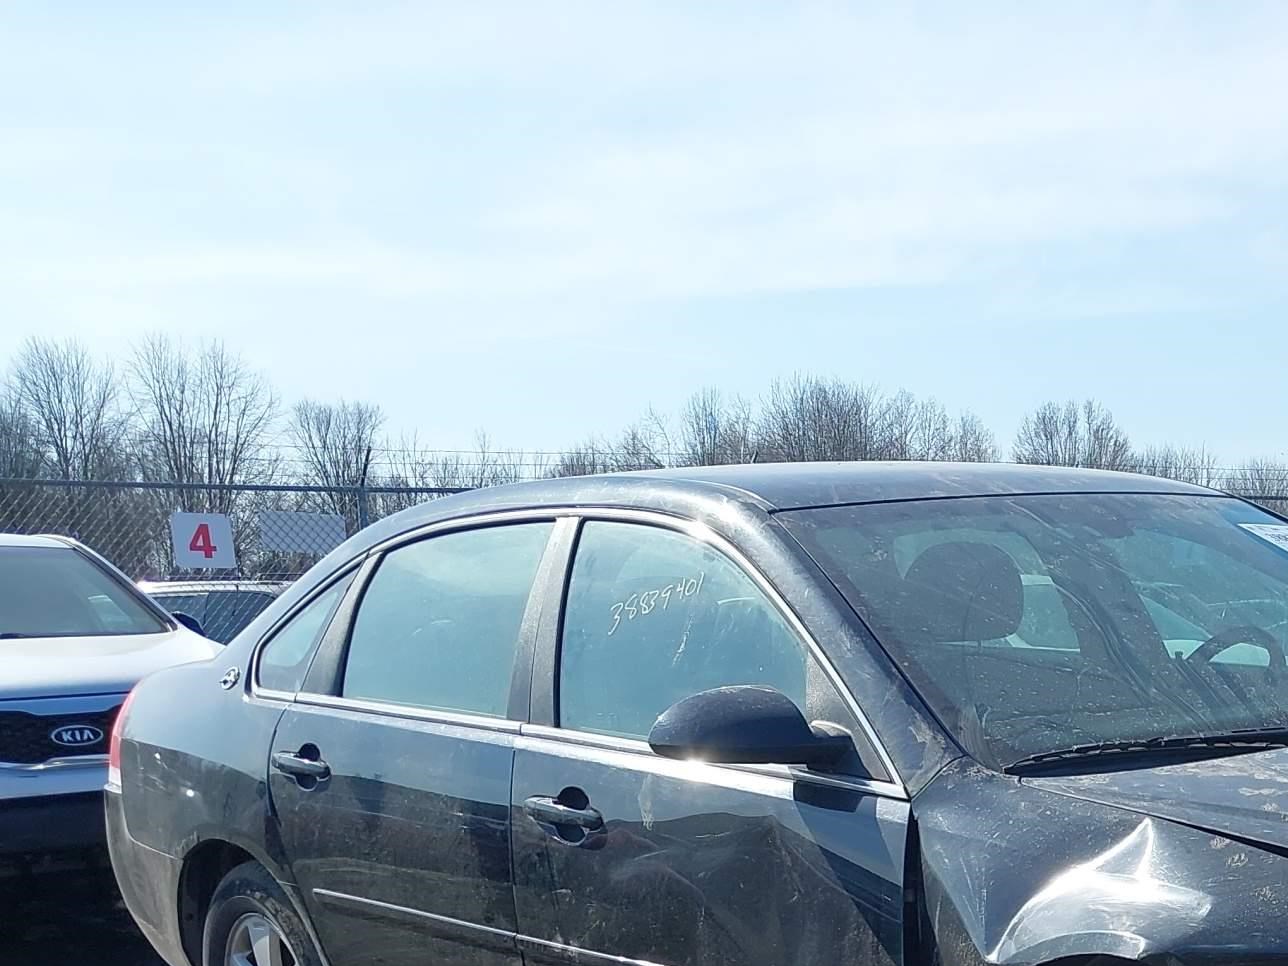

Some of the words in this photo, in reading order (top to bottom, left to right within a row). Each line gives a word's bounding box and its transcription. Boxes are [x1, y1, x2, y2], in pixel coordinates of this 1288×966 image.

[189, 523, 217, 559] 4
[607, 571, 705, 636] 38839401
[61, 729, 95, 742] KIA
